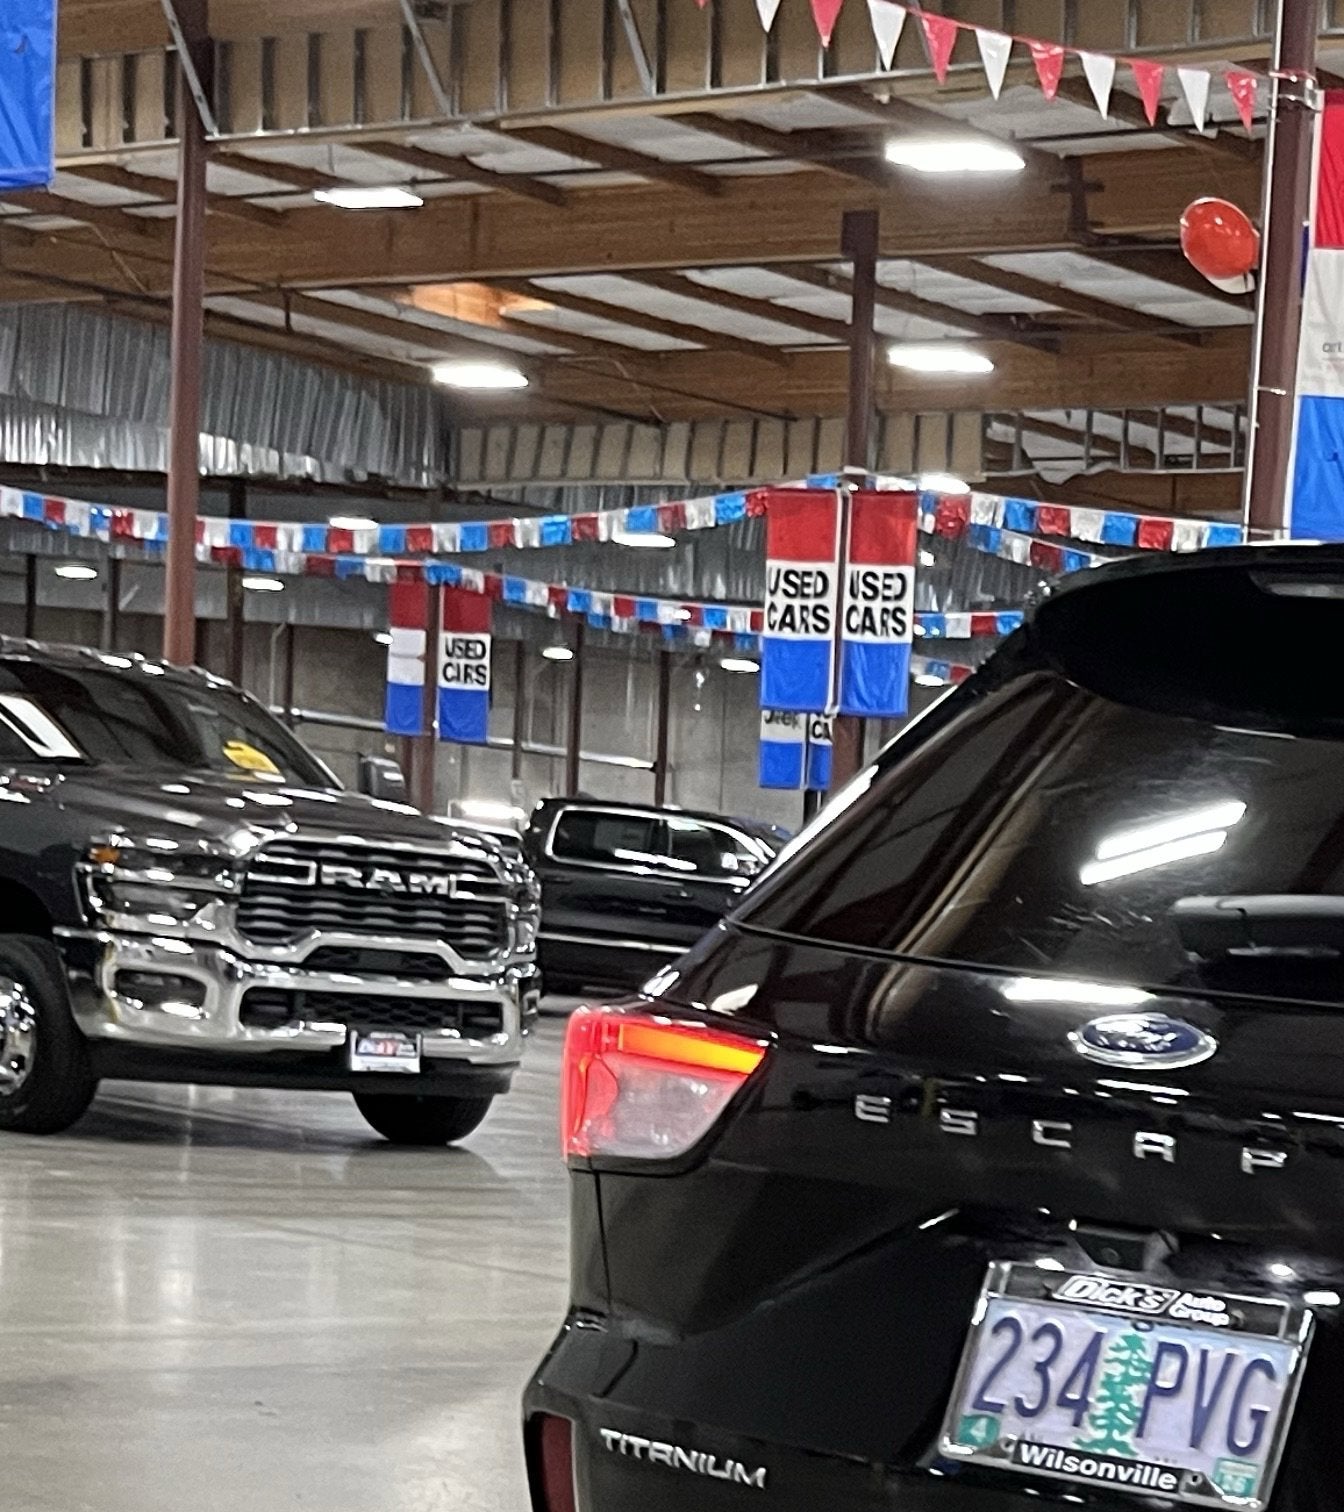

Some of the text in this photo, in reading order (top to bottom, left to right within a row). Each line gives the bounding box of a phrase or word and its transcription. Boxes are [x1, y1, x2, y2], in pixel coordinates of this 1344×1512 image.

[768, 567, 829, 599] USED
[849, 571, 907, 601] USED
[767, 602, 830, 634] CARS
[845, 604, 907, 637] CARS
[445, 636, 486, 660] USED
[320, 864, 450, 895] RAM
[1169, 1304, 1230, 1326] Group
[1181, 1292, 1227, 1312] Auto
[972, 1316, 1277, 1457] 234 PVG
[600, 1427, 767, 1489] TITANIUM
[1020, 1442, 1178, 1491] Wilsonville
